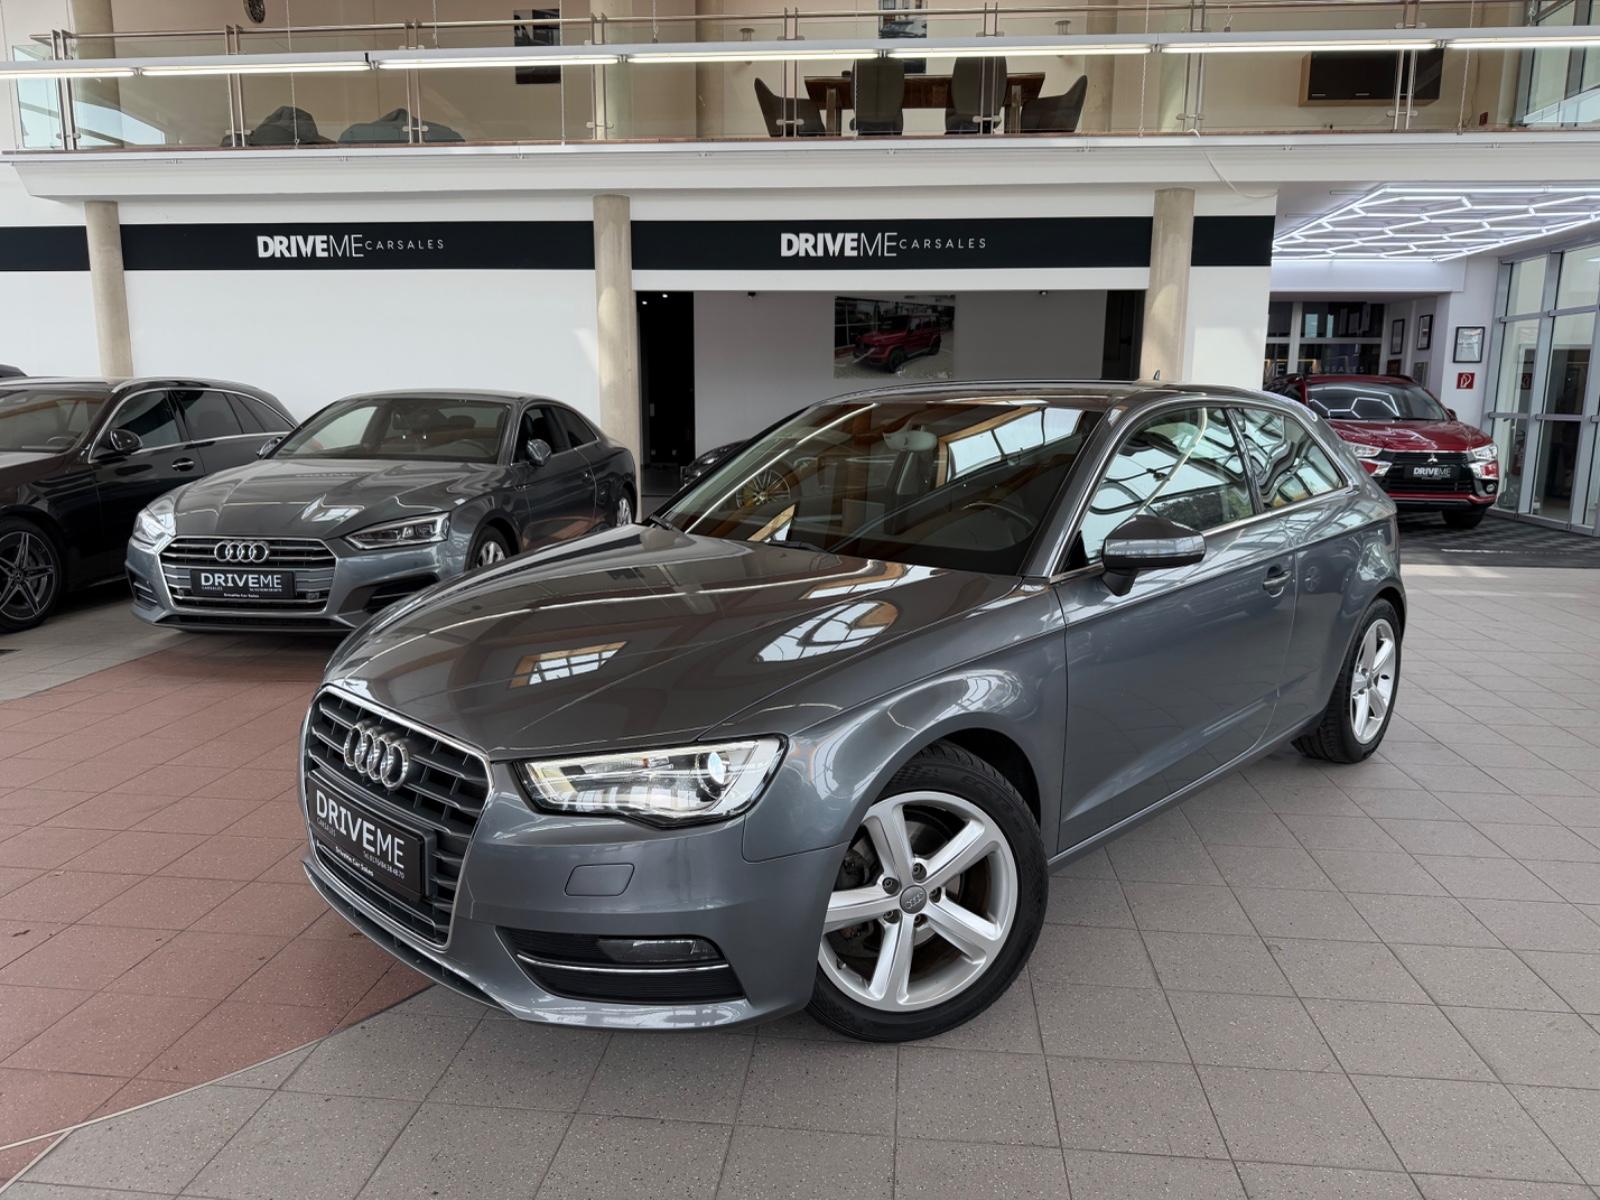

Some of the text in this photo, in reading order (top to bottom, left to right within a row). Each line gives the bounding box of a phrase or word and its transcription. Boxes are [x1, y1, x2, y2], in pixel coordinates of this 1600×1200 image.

[256, 234, 445, 258] DRIVEME CARSALES
[780, 232, 987, 257] DRIVEME CARSALES
[1413, 466, 1451, 477] DRIVEME
[200, 572, 282, 588] DRIVEME
[316, 789, 405, 869] DRIVEME
